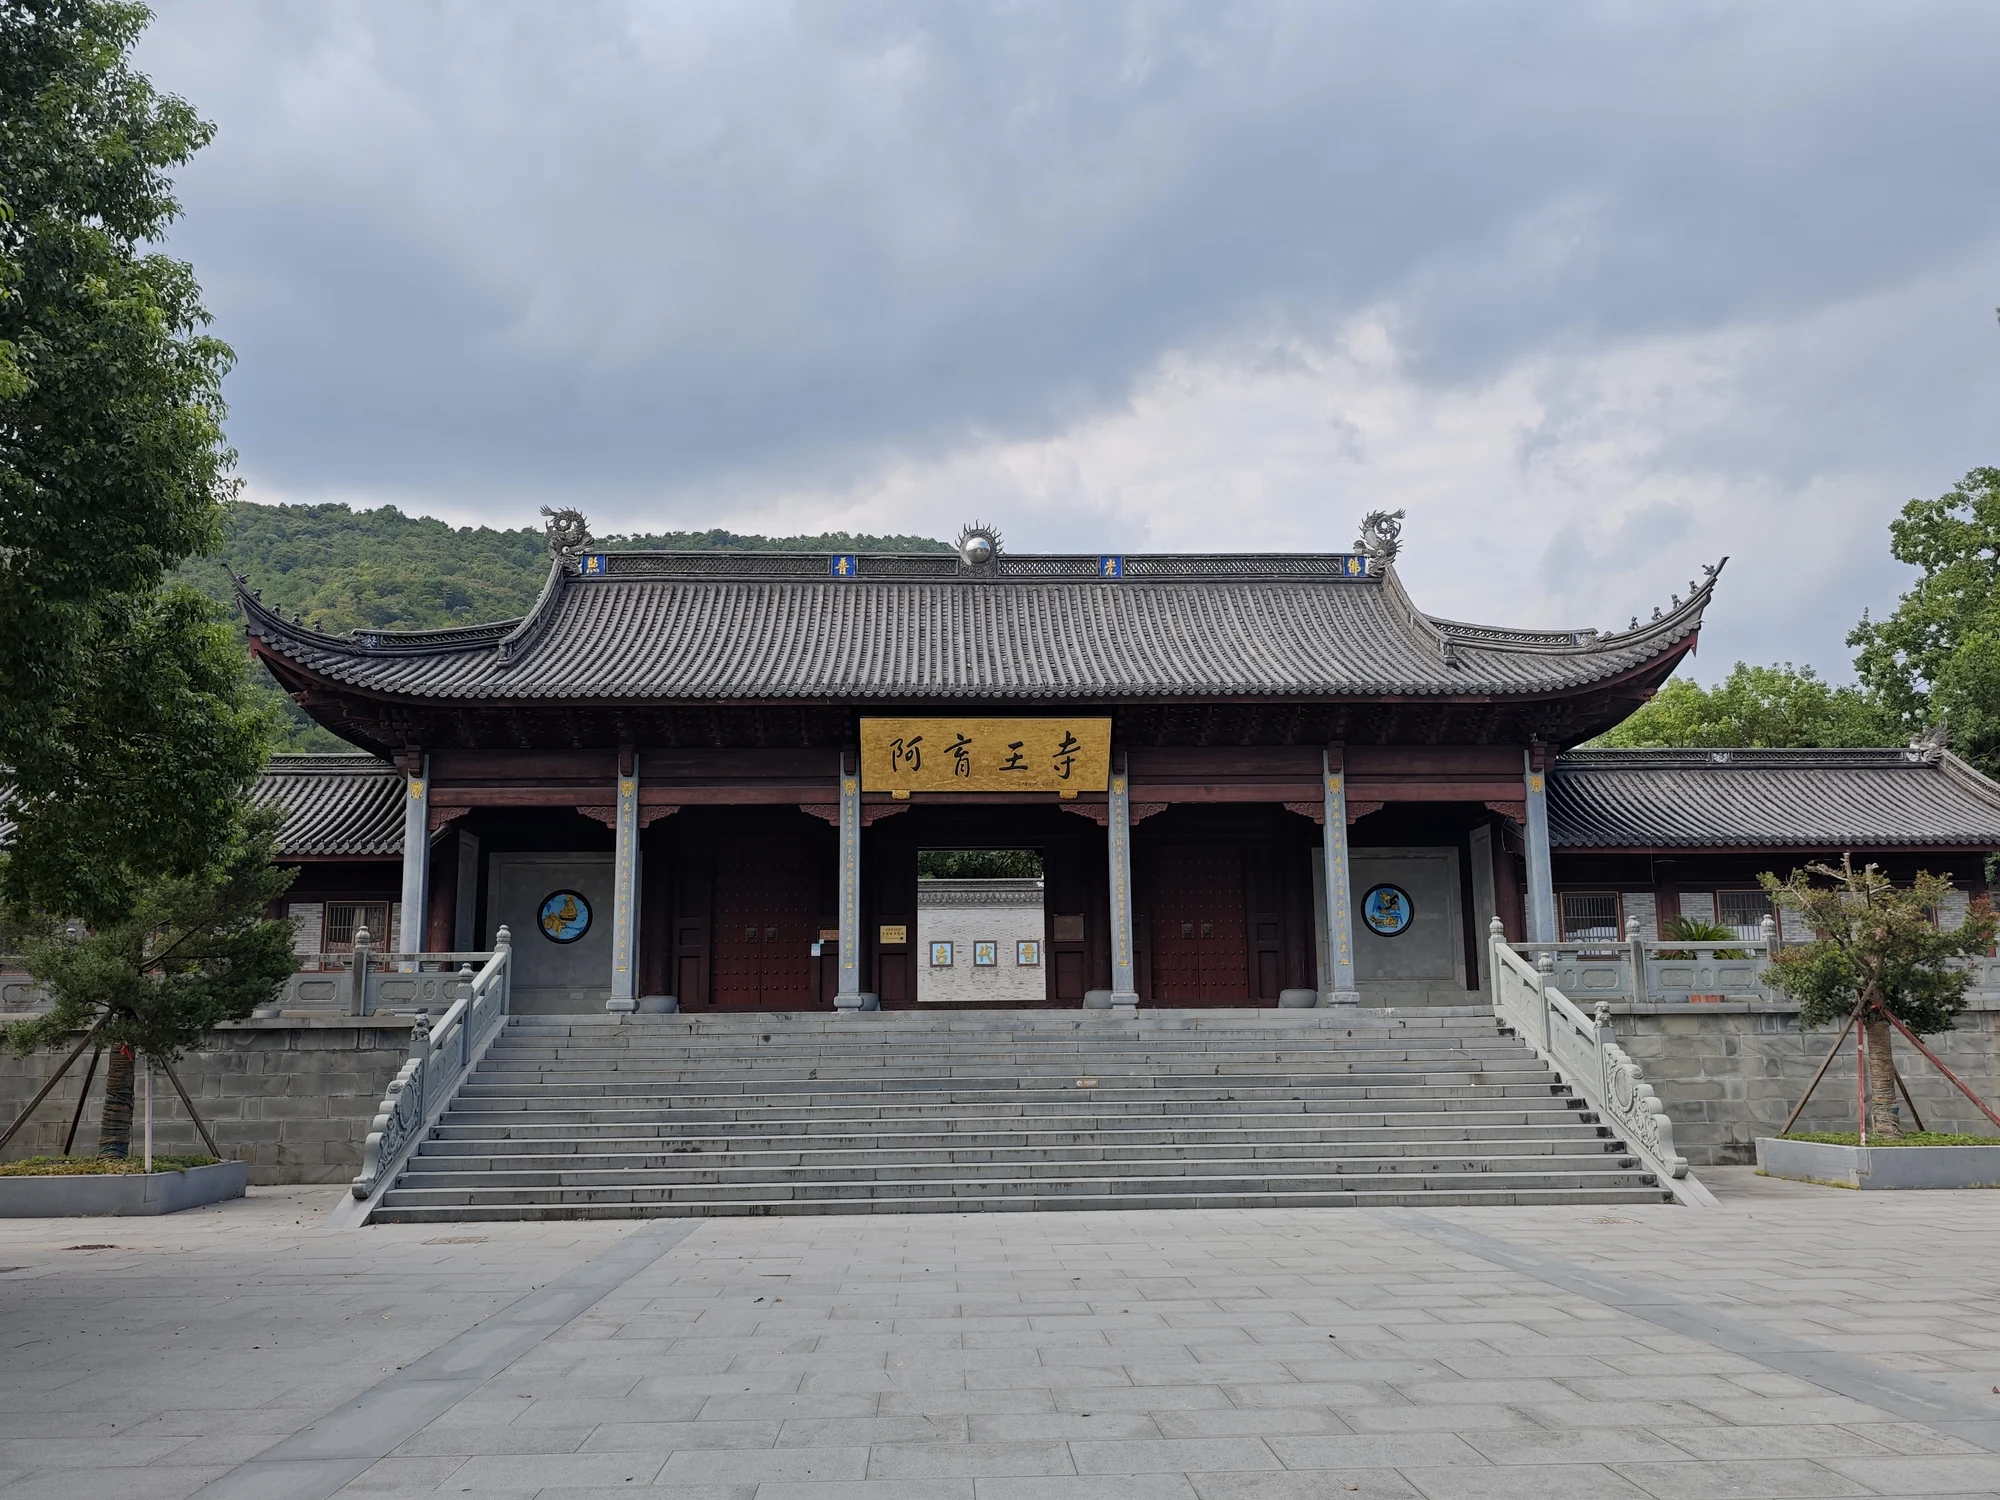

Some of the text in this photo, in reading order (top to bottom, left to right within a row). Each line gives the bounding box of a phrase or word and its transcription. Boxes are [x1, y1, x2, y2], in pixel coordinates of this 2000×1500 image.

[835, 556, 850, 575] 普
[1104, 558, 1117, 576] 光
[1347, 556, 1362, 576] 佛
[889, 730, 1081, 780] 阿育王寺
[936, 944, 948, 964] 古
[977, 944, 994, 963] 代
